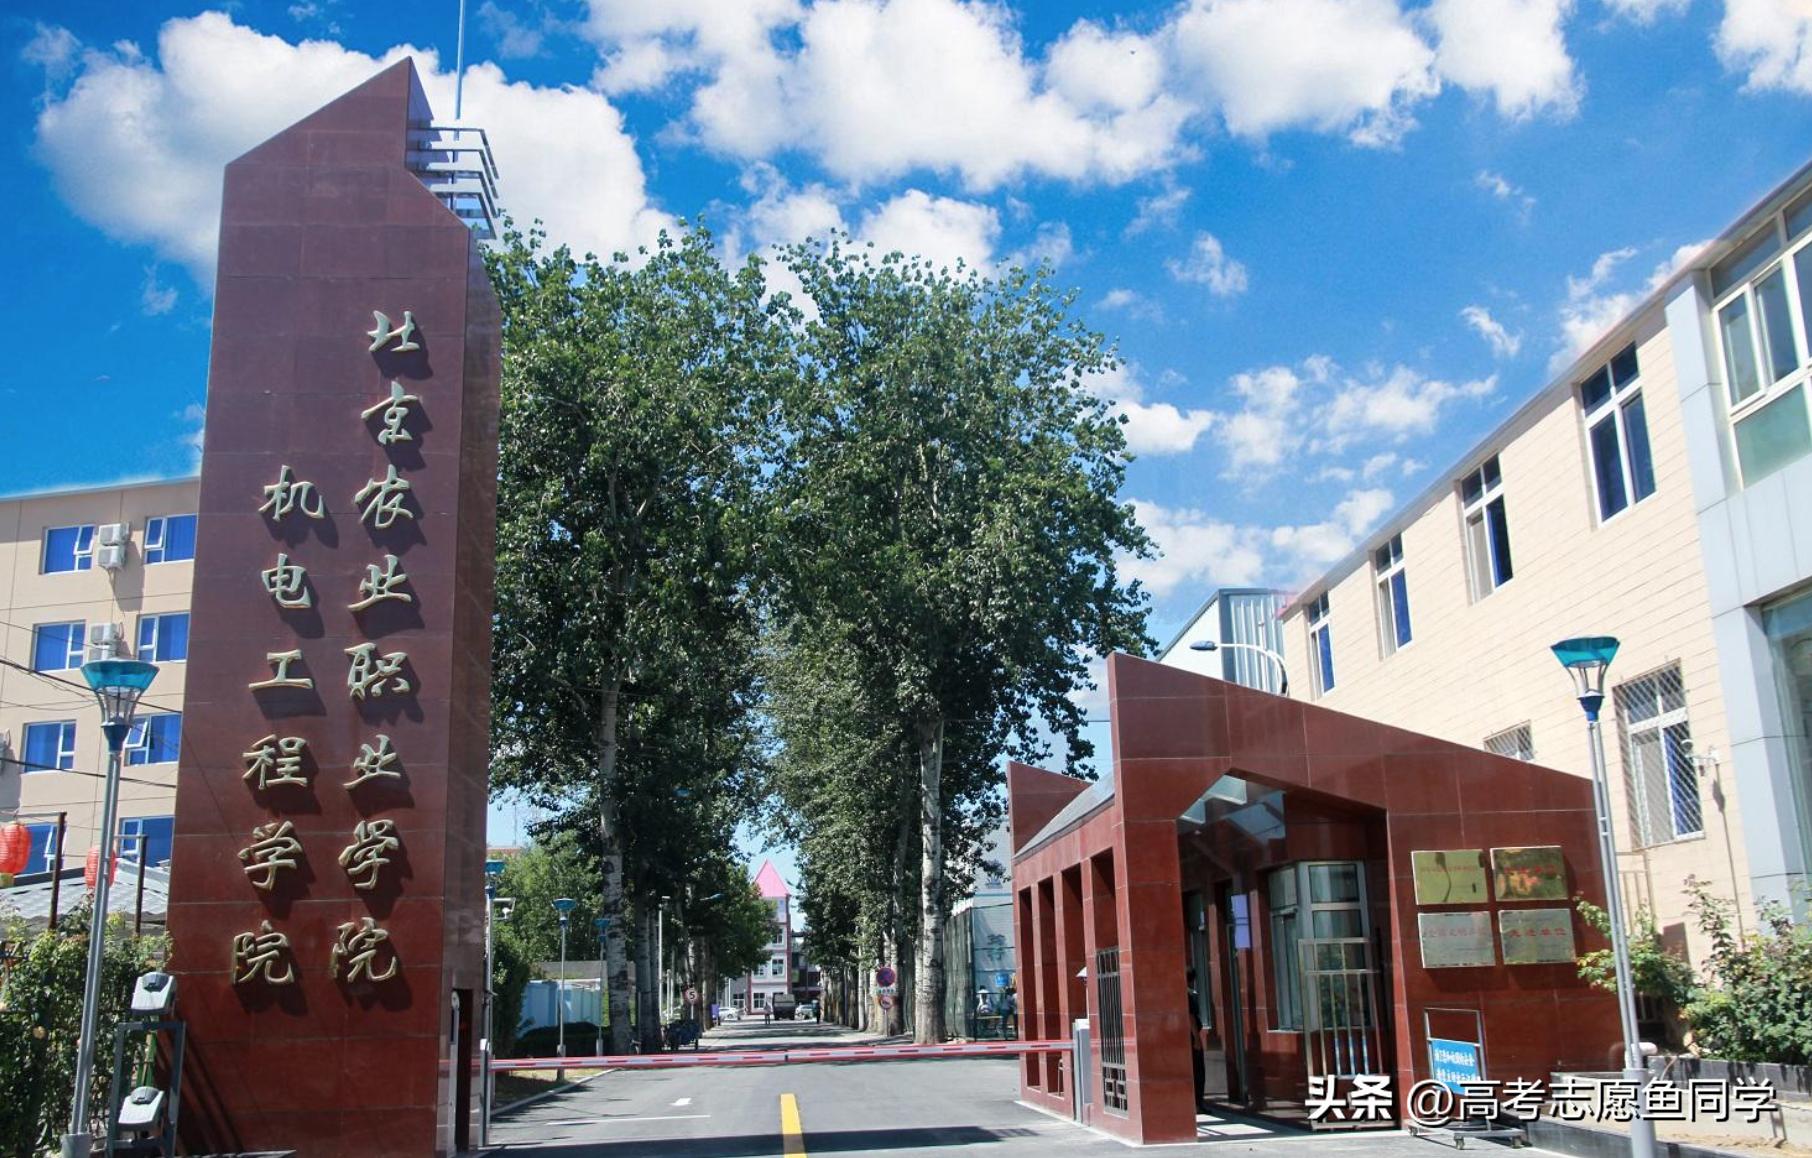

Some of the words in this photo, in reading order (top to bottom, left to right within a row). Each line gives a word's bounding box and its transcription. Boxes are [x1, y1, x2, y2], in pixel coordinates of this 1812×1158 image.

[229, 464, 324, 986] 机电工程学院
[329, 309, 421, 983] 北京农业职业学院
[689, 991, 696, 1000] 5
